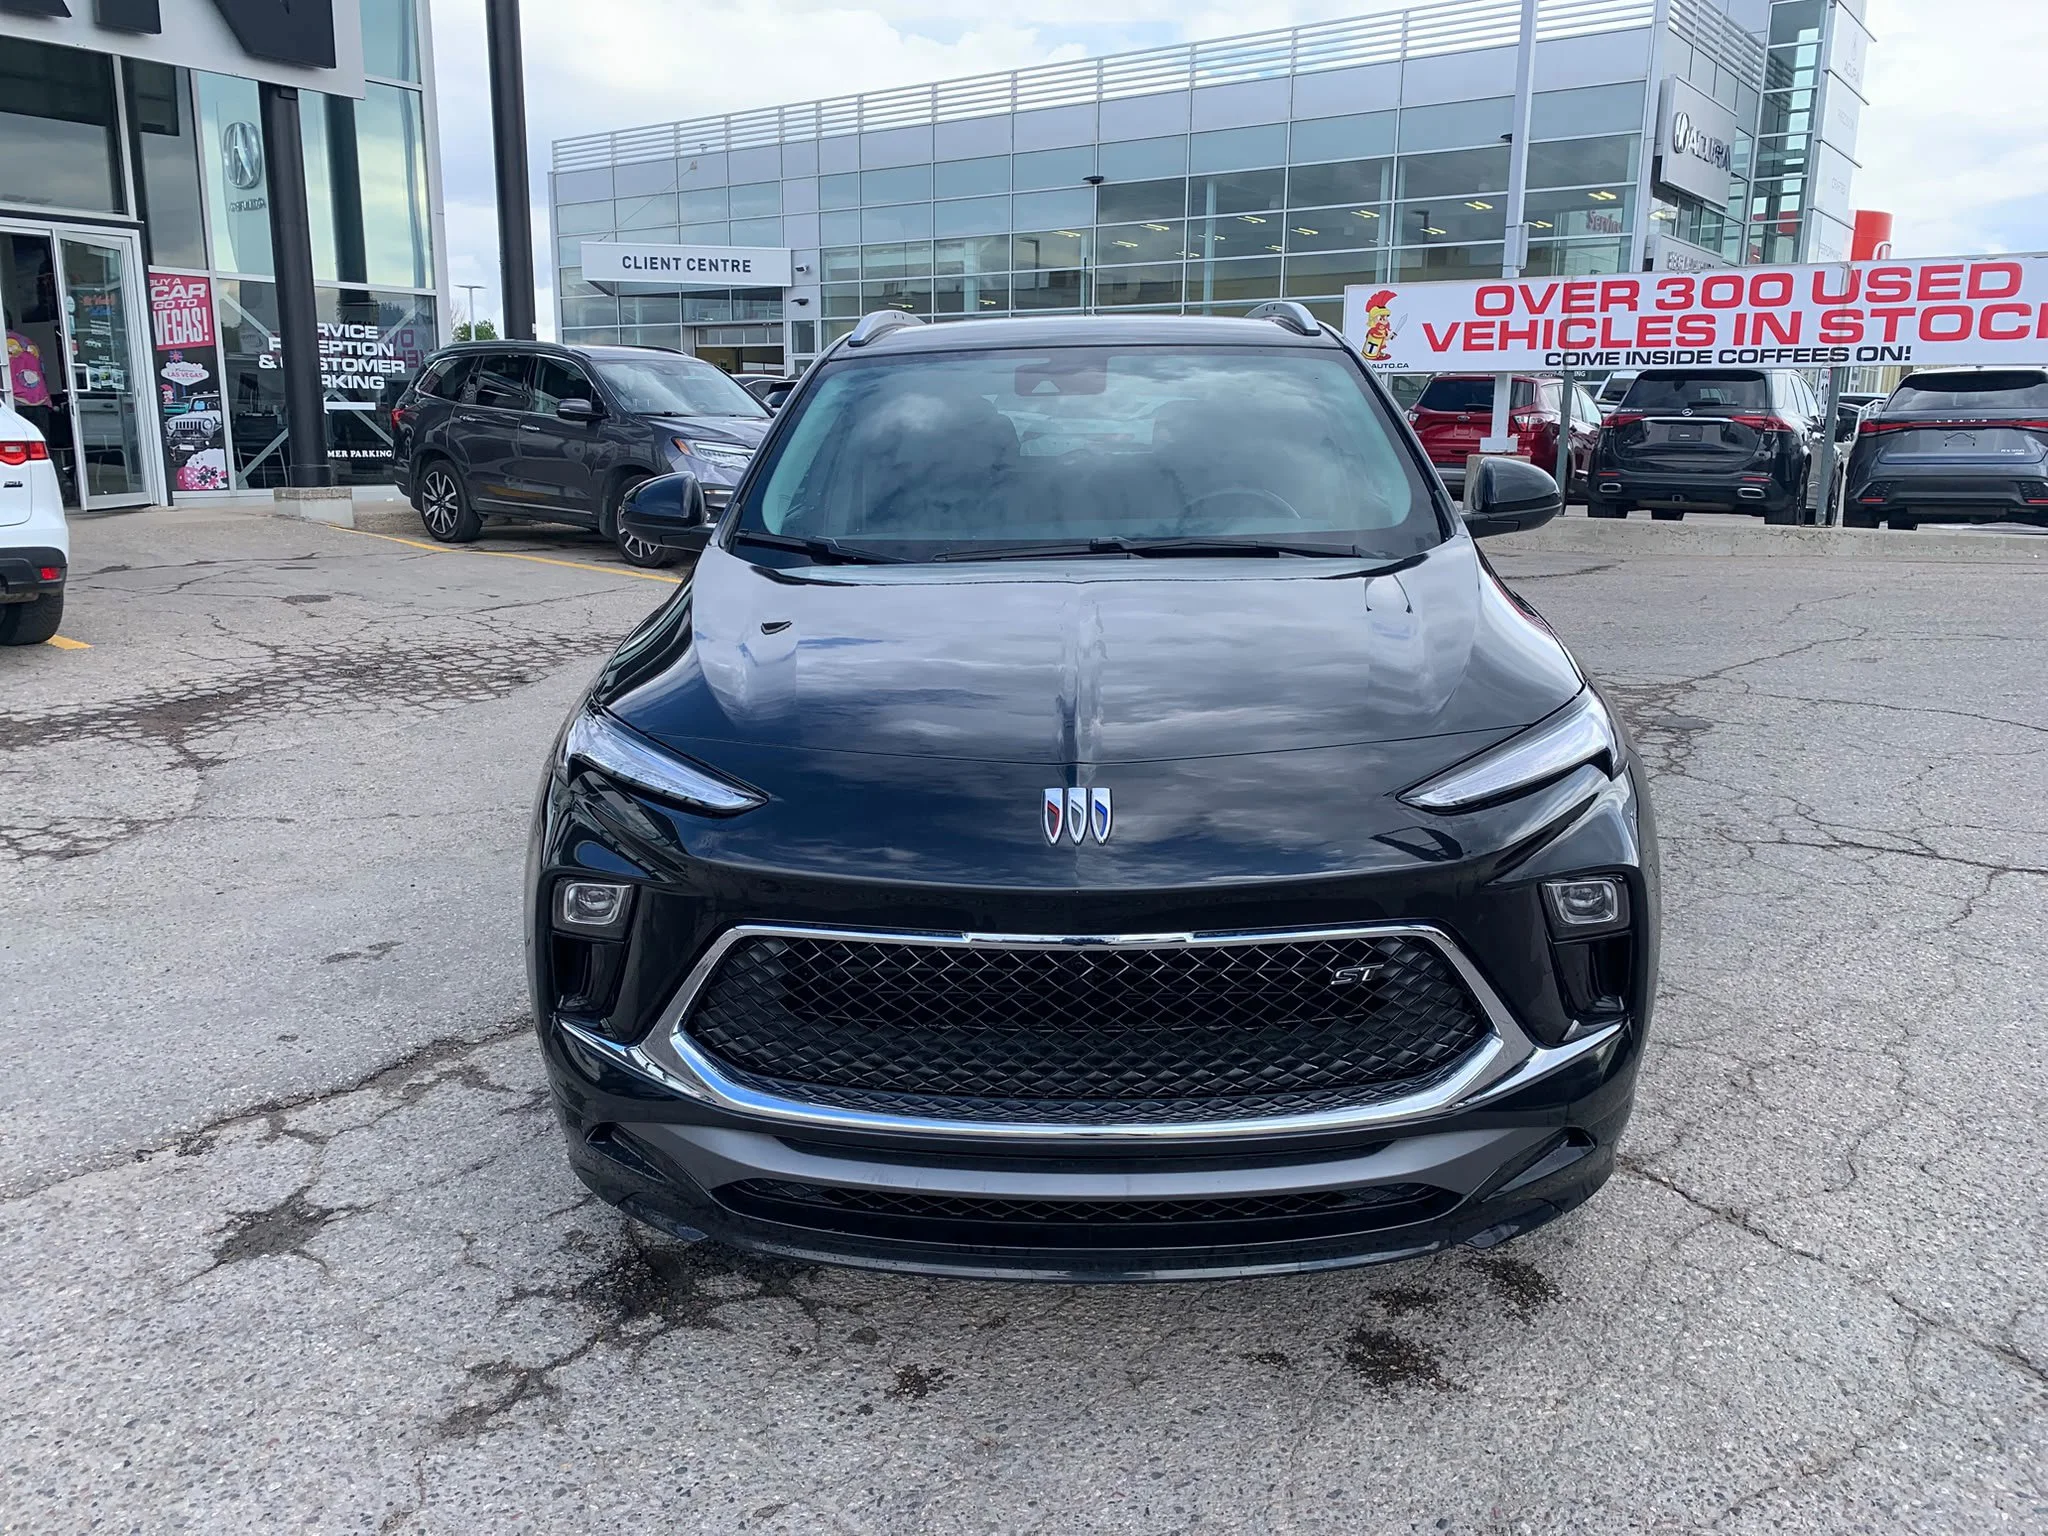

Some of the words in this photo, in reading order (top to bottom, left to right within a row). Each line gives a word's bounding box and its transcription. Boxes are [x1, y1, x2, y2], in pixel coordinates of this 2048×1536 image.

[1687, 129, 1731, 172] ACURA
[622, 256, 682, 271] CLIENT
[686, 258, 751, 273] CENTRE
[151, 283, 206, 301] CAR
[1475, 279, 1640, 317] OVER
[1655, 272, 1794, 311] 300
[1811, 262, 2023, 306] USED
[153, 301, 175, 310] GO
[178, 299, 198, 308] TO
[152, 307, 209, 346] VEGAS!
[317, 323, 379, 339] RVICE
[1422, 313, 1717, 352] VEHICLES
[1733, 311, 1803, 346] IN
[258, 354, 277, 369] &
[1545, 352, 1620, 367] COME
[1625, 350, 1712, 366] INSIDE
[1718, 347, 1850, 365] COFFEES
[1855, 345, 1911, 362] ON!
[322, 374, 385, 390] RKING
[350, 449, 392, 458] PARKING
[1331, 963, 1384, 985] ST
